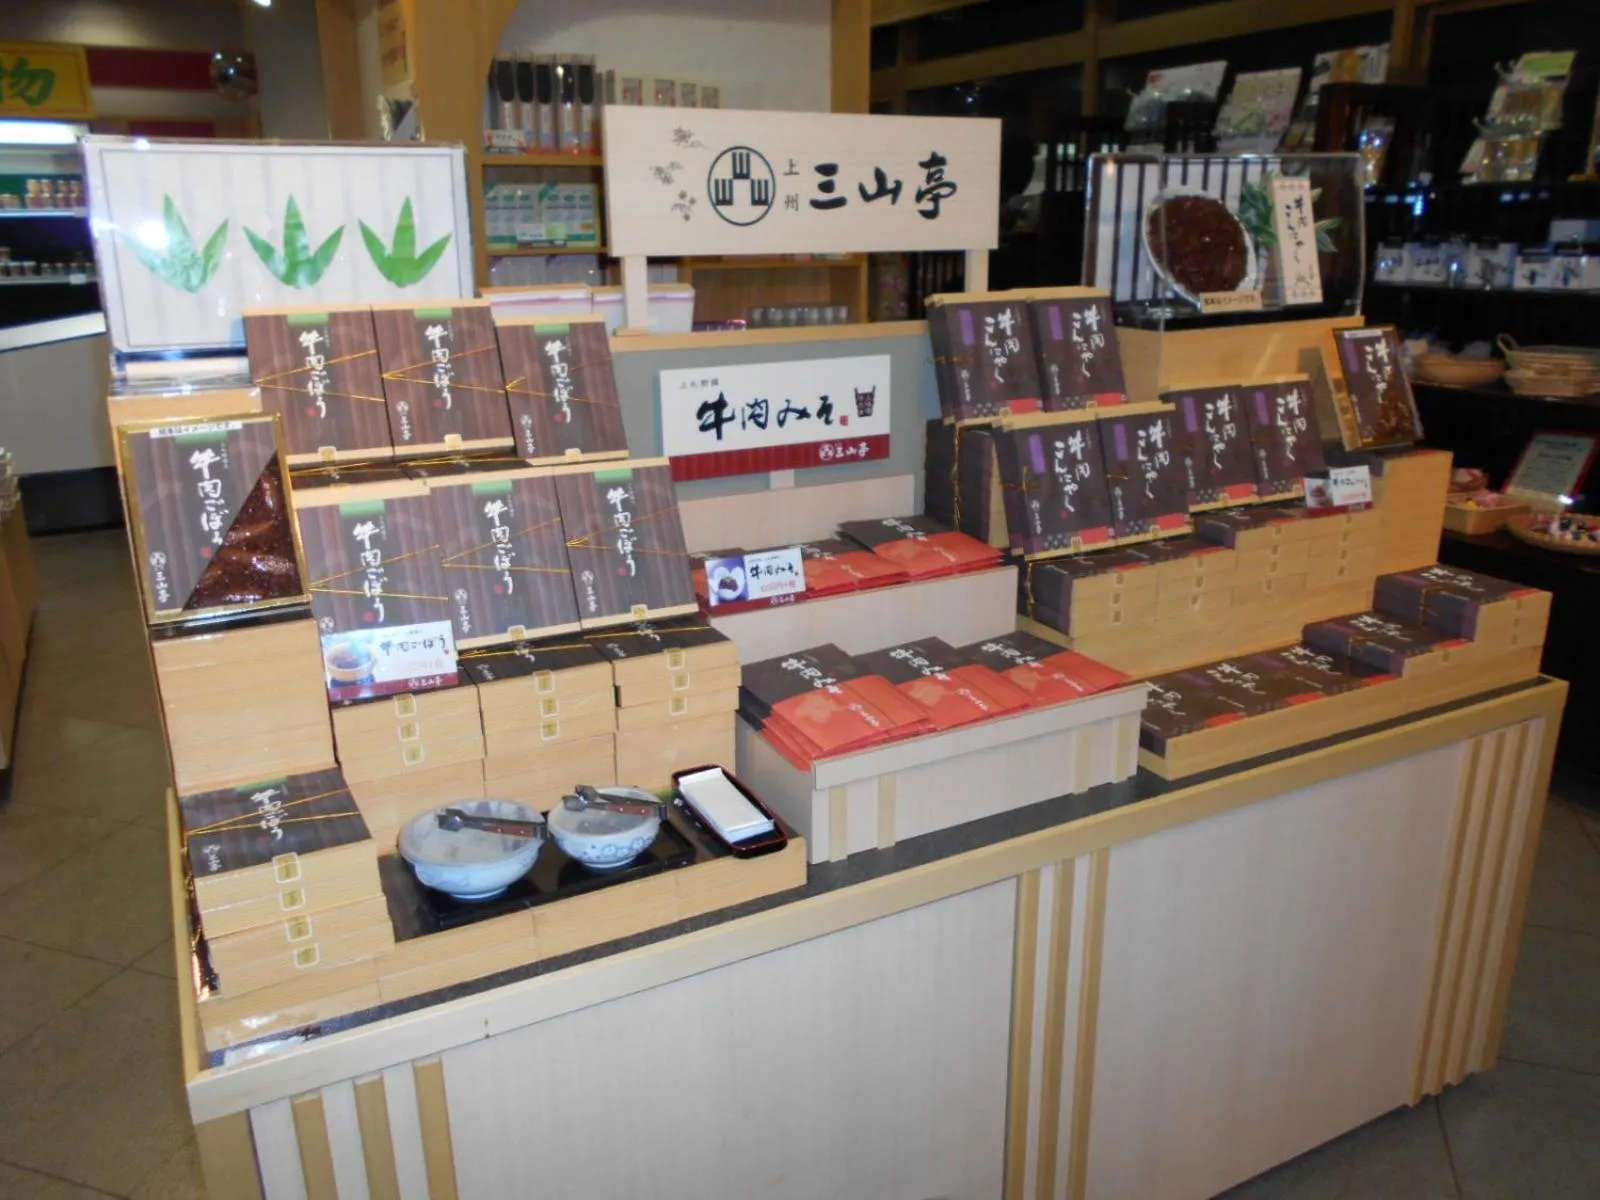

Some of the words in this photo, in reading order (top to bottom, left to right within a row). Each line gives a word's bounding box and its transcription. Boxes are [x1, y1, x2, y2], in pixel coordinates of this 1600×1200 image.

[783, 158, 800, 211] 上州
[809, 151, 957, 219] 三山亭
[696, 391, 834, 441] 牛肉みそ
